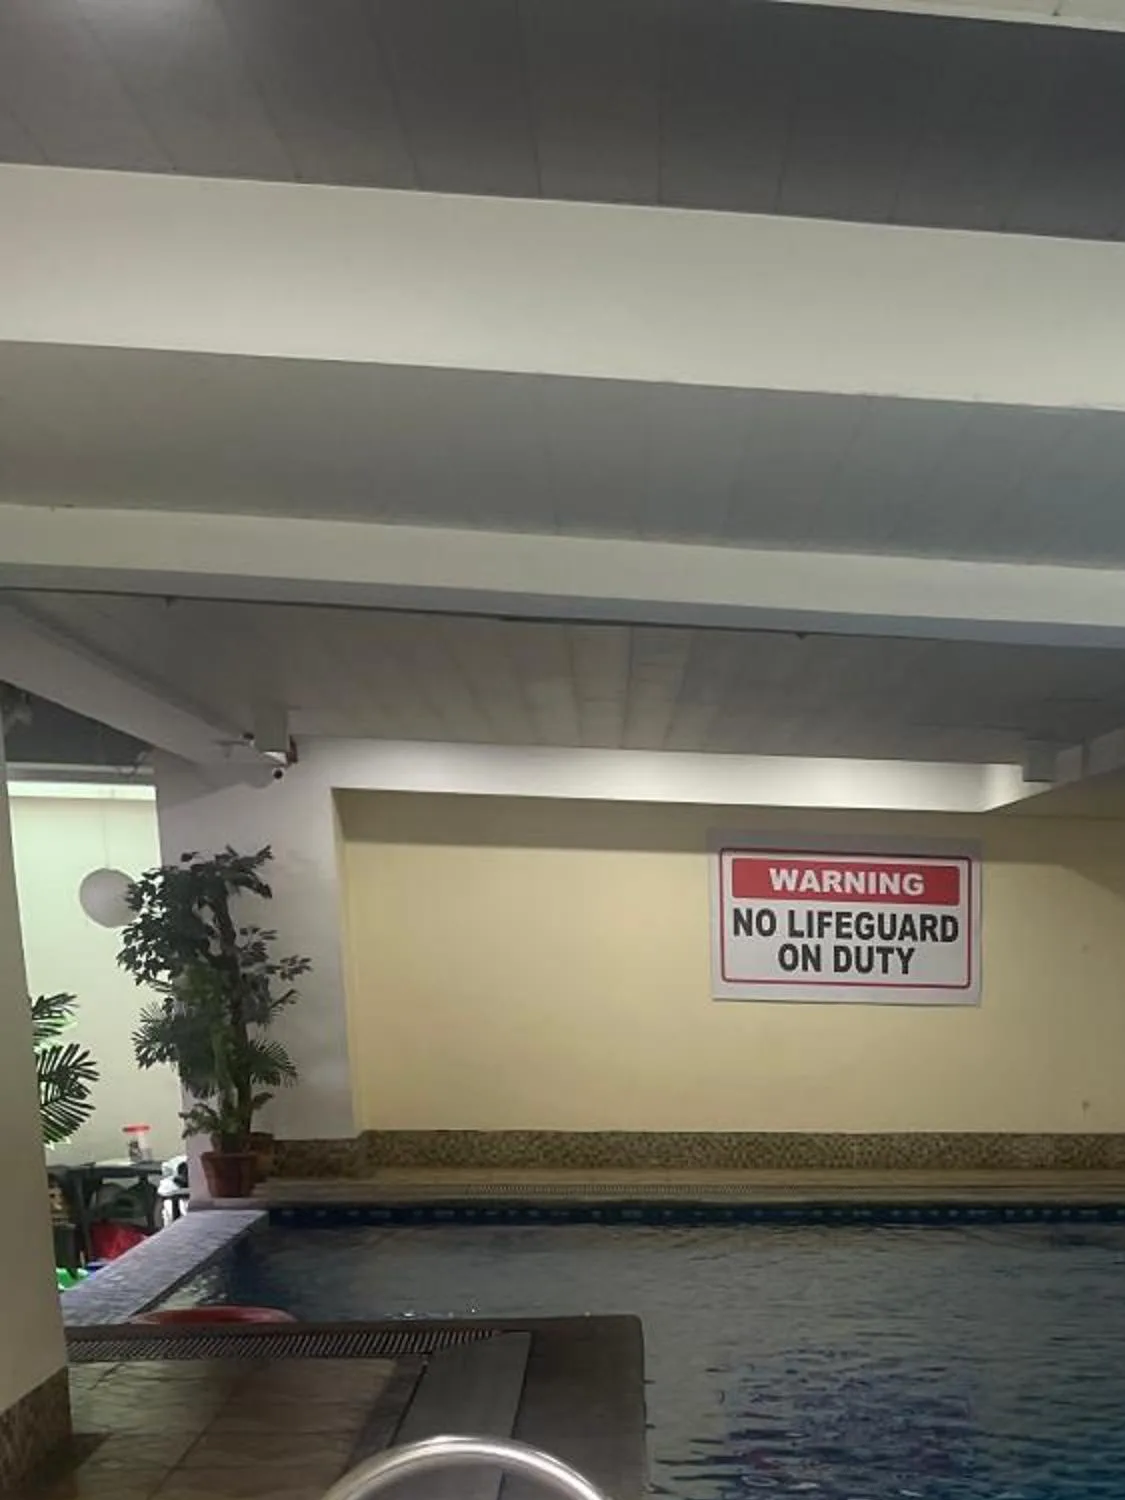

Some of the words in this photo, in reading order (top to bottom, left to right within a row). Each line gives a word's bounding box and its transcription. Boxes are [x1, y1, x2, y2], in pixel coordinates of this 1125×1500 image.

[768, 867, 925, 897] WARNING
[732, 907, 778, 937] NO
[788, 909, 959, 943] LIFEGUARD
[777, 943, 822, 973] ON
[833, 945, 915, 975] DUTY
